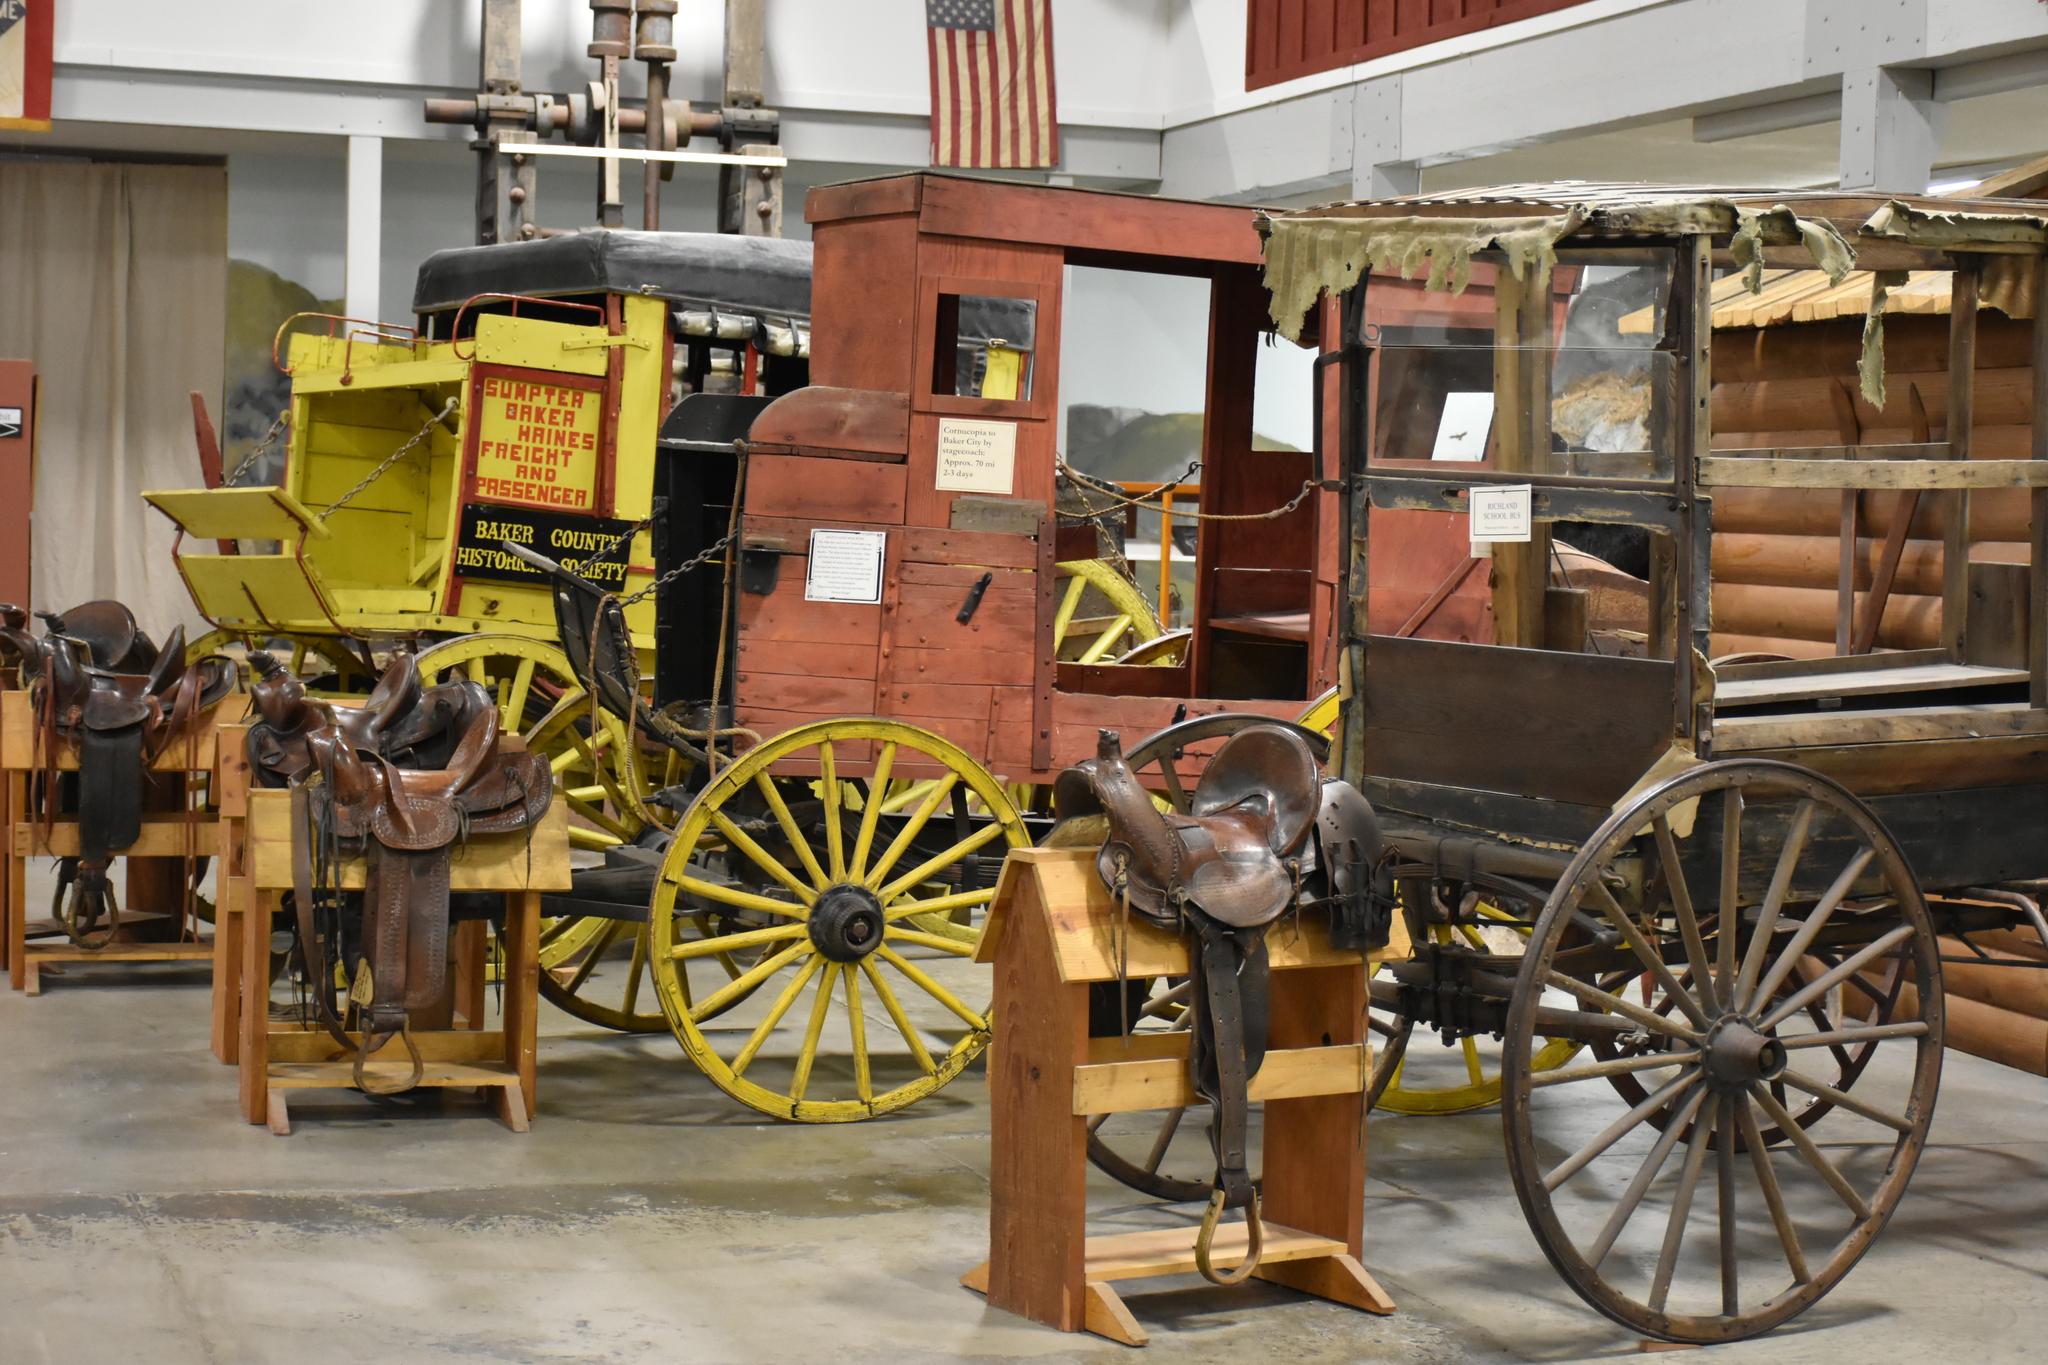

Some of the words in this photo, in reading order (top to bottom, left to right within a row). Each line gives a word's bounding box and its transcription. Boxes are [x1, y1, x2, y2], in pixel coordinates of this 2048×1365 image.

[485, 379, 585, 409] SUMPTER
[505, 402, 576, 428] BAKER
[518, 425, 595, 451] HAINES
[943, 426, 987, 437] Cornucopia
[943, 437, 965, 445] Baker
[966, 438, 981, 448] City
[983, 439, 992, 448] by
[481, 440, 573, 467] FREIGHT
[944, 458, 973, 468] Approx.
[516, 464, 557, 483] AND
[943, 469, 955, 477] 2-3
[956, 470, 973, 479] days
[475, 476, 587, 506] PASSENGER
[1487, 502, 1518, 510] RICHLAND
[1483, 512, 1509, 520] SCHOOL
[475, 520, 534, 544] BAKER
[550, 528, 622, 553] COUNTY
